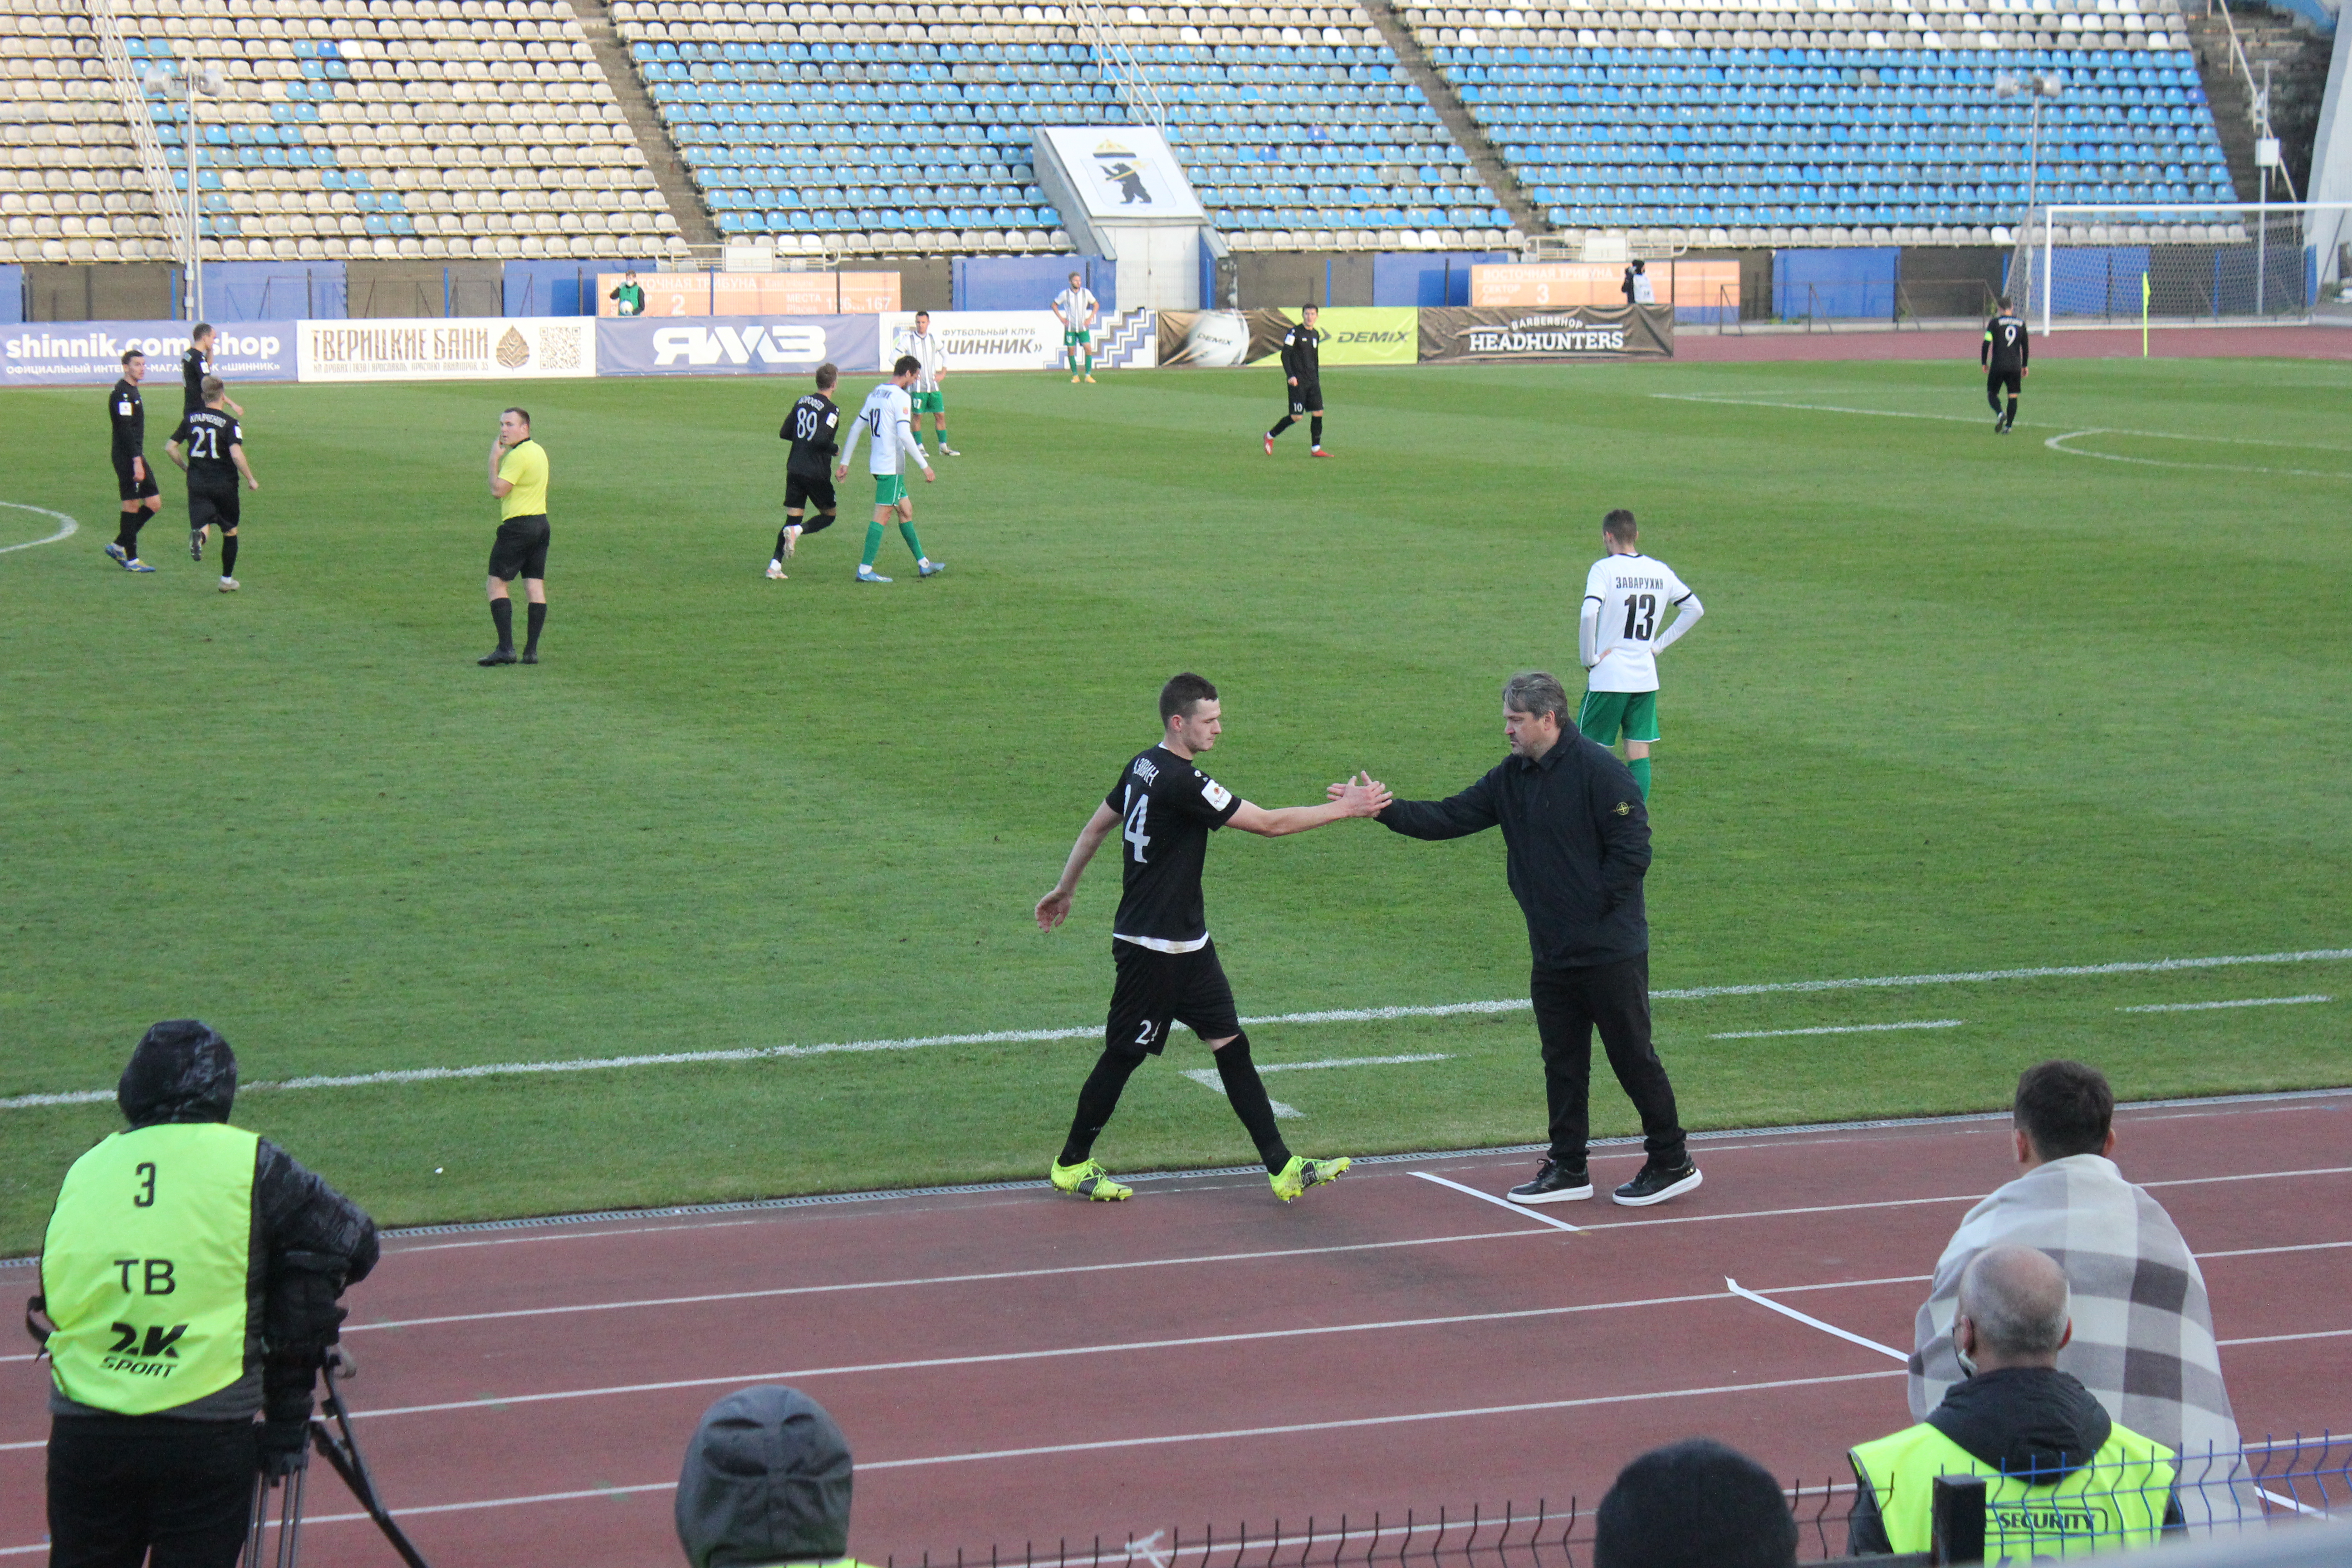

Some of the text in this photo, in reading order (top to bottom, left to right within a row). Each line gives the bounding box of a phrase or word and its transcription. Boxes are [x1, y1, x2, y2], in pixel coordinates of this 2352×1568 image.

[610, 277, 757, 289] ВТОЧНАЯ ТРИБУНА
[1483, 268, 1555, 279] ВОСТОЧНАЯ
[1558, 267, 1612, 279] ТРИБУНА
[786, 293, 821, 303] МЕСТА
[1482, 284, 1521, 294] СЕКТОР
[1537, 283, 1549, 304] 3
[671, 293, 686, 316] 2
[942, 328, 1036, 336] ФУТБОЛЬНЫЙ КЛУБ
[1511, 315, 1584, 331] BARBERSHOP
[311, 327, 489, 362] ТВЕРИЦКИЕ БАНИ
[1469, 331, 1624, 351] HEADHUNTERS
[2004, 325, 2016, 347] 9
[6, 363, 91, 375] ОФИЦИАЛЬНЫЙ
[222, 362, 280, 372] «ШИННИК»
[1293, 402, 1303, 412] 10
[797, 407, 818, 441] 89
[869, 408, 881, 437] 12
[190, 425, 220, 459] 21
[1616, 576, 1663, 590] ЗАВАРУХИН
[1623, 594, 1656, 641] 13
[133, 1161, 156, 1208] 3
[108, 1321, 189, 1358] 2K
[99, 1356, 178, 1379] SPORT
[1999, 1512, 2096, 1530] SECURITY
